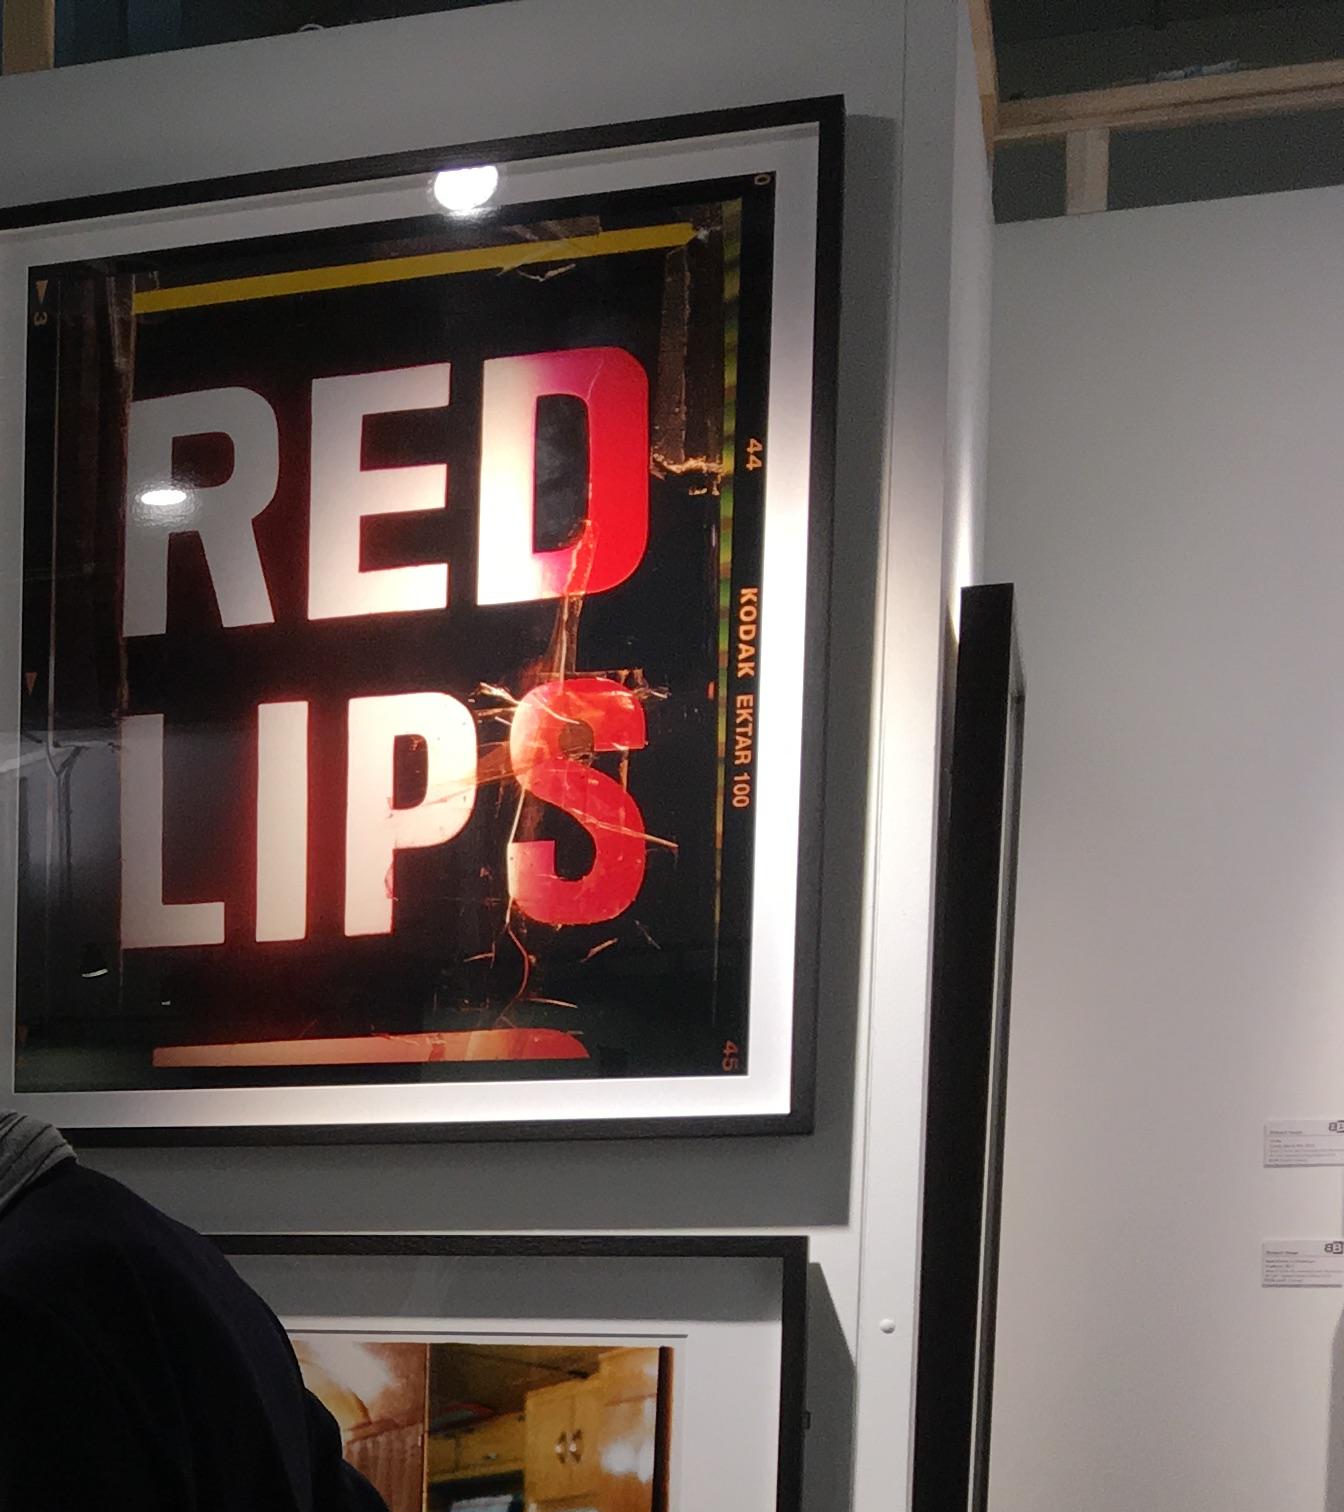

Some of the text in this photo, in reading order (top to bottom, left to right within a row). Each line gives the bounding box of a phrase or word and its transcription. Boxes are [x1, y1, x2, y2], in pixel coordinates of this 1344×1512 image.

[122, 346, 650, 638] RED
[746, 438, 763, 471] 44
[732, 587, 759, 808] KODAK EKTAR 100
[121, 672, 649, 949] LIPS
[722, 1040, 737, 1072] 45
